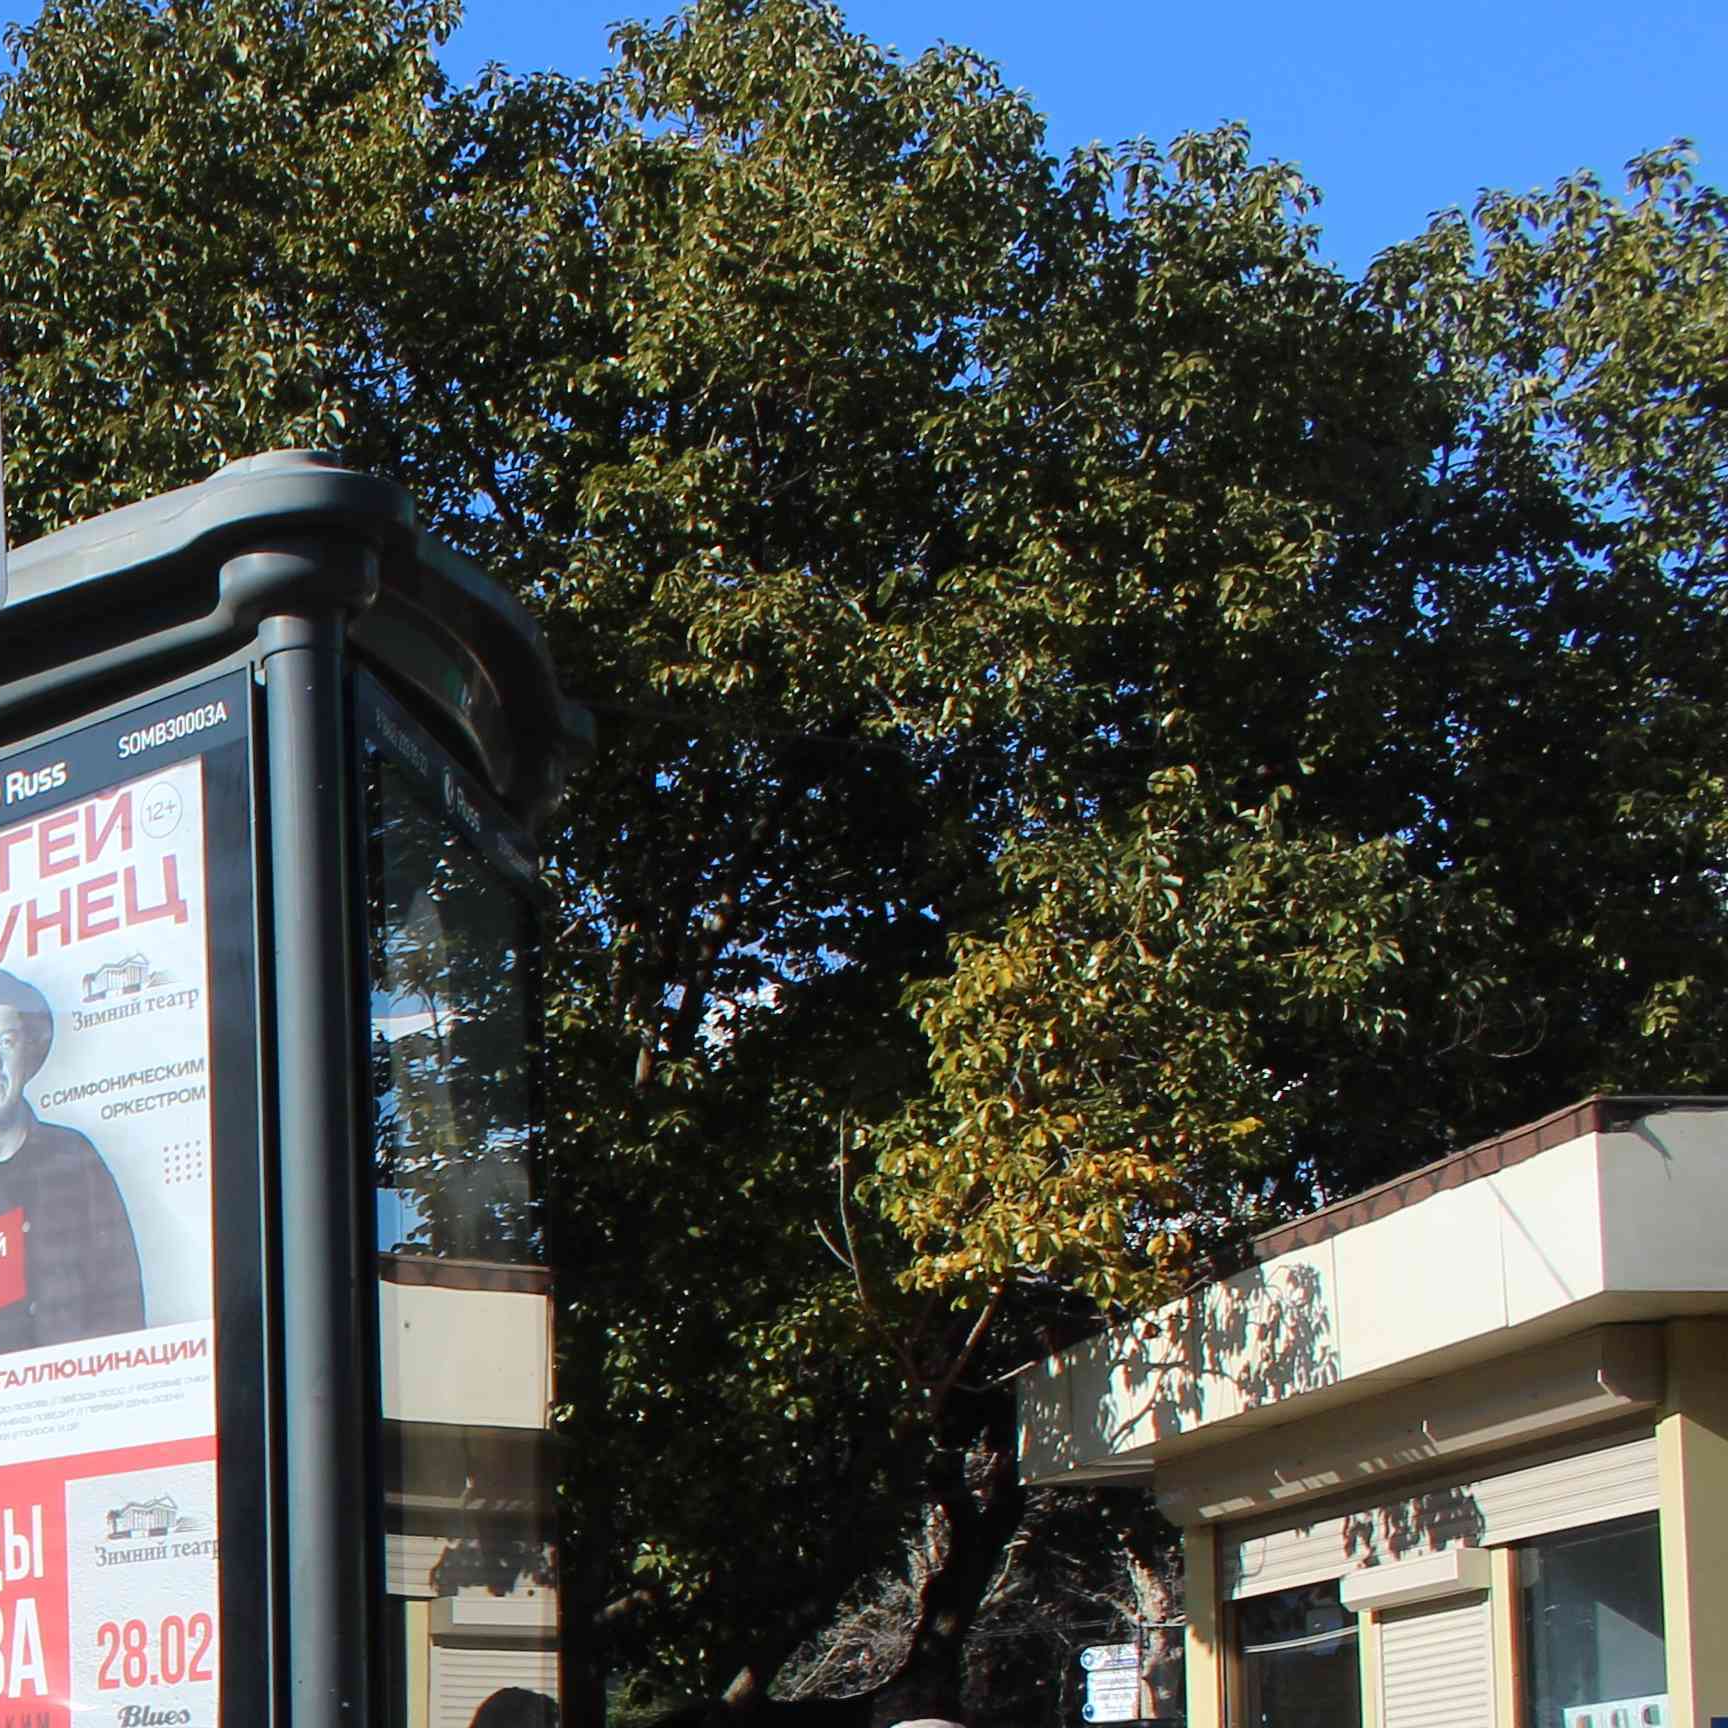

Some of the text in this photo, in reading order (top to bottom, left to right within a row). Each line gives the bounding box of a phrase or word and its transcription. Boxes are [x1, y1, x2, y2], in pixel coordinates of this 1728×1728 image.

[118, 701, 227, 758] SOMB30003A
[6, 762, 67, 804] Russ
[145, 801, 176, 823] 12+
[72, 988, 199, 1031] Зимний театр
[52, 1058, 205, 1106] СИМФОНИЧЕСКИМ
[101, 1085, 206, 1120] ОРКЕСТРОМ
[95, 1541, 167, 1568] Зимний
[96, 1612, 214, 1691] 28.02
[117, 1705, 191, 1728] Blues
